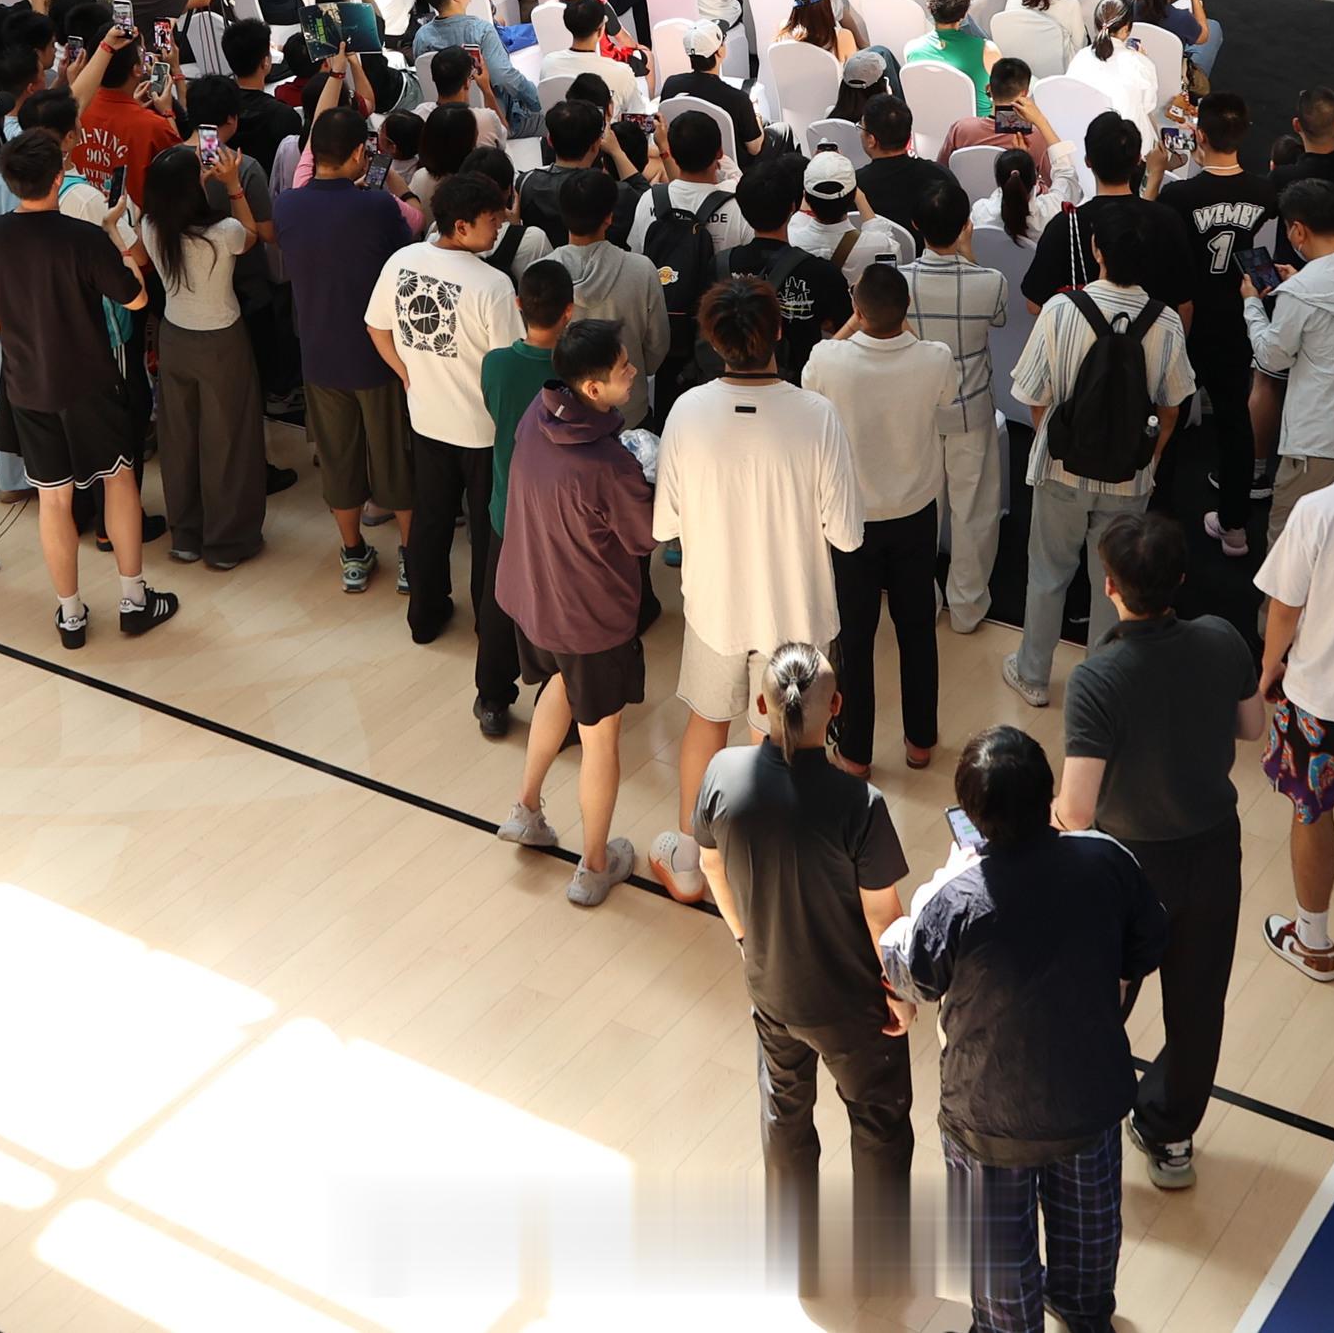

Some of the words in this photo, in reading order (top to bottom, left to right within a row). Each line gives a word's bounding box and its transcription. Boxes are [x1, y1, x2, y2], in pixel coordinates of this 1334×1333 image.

[86, 147, 111, 168] 90'S
[1193, 202, 1266, 234] WEMBY
[1207, 231, 1236, 274] 1
